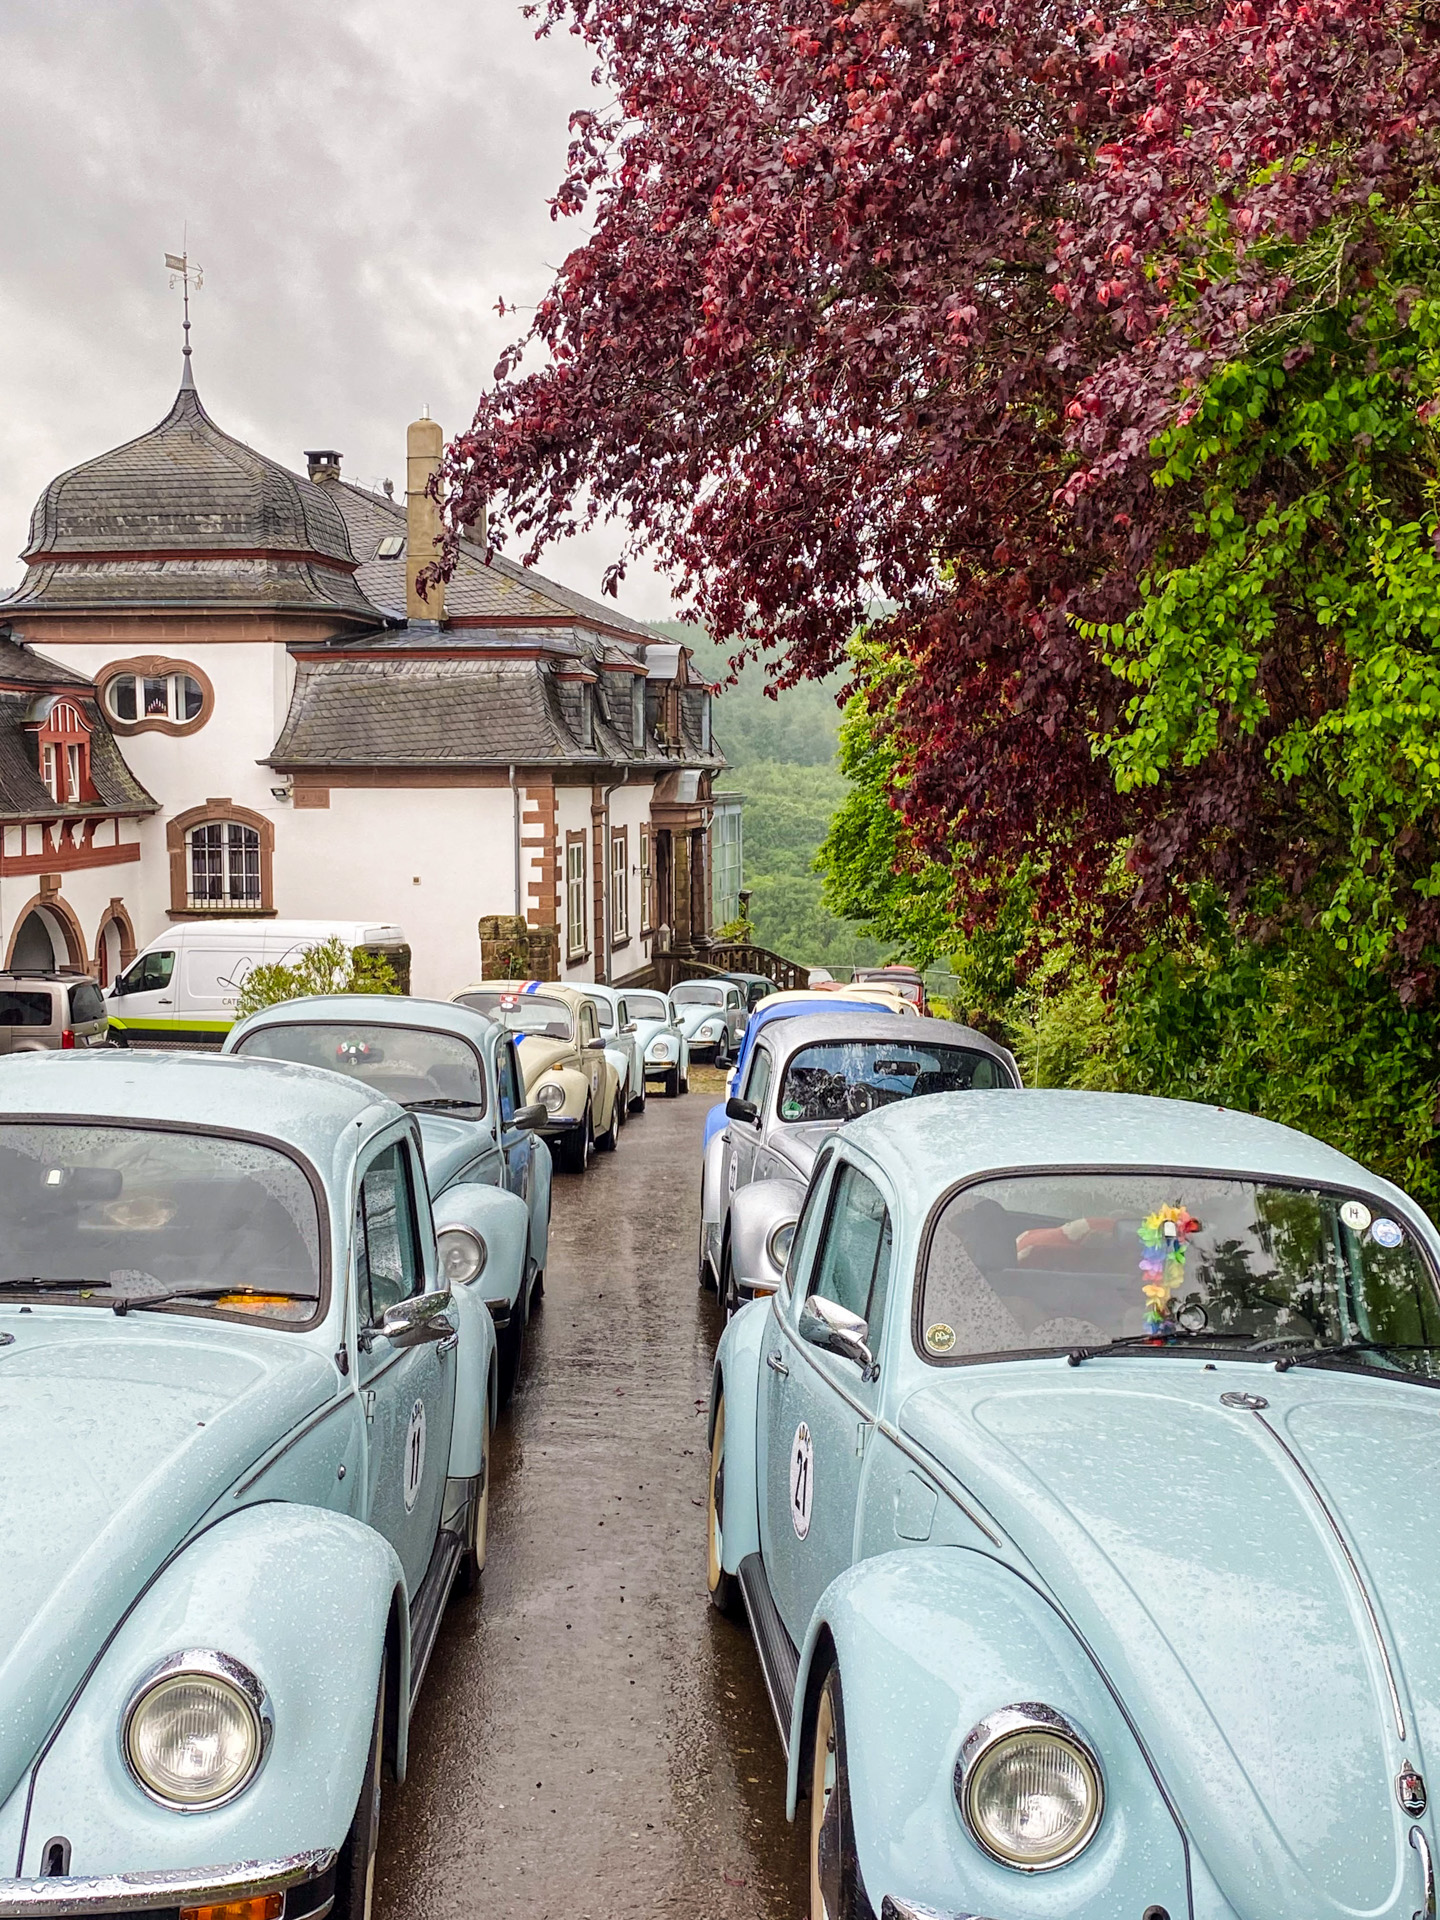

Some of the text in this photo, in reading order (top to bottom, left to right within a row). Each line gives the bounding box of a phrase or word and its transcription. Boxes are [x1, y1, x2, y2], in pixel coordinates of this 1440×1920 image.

[1349, 1207, 1359, 1219] 14
[410, 1427, 421, 1491] 11
[795, 1449, 808, 1517] 21
